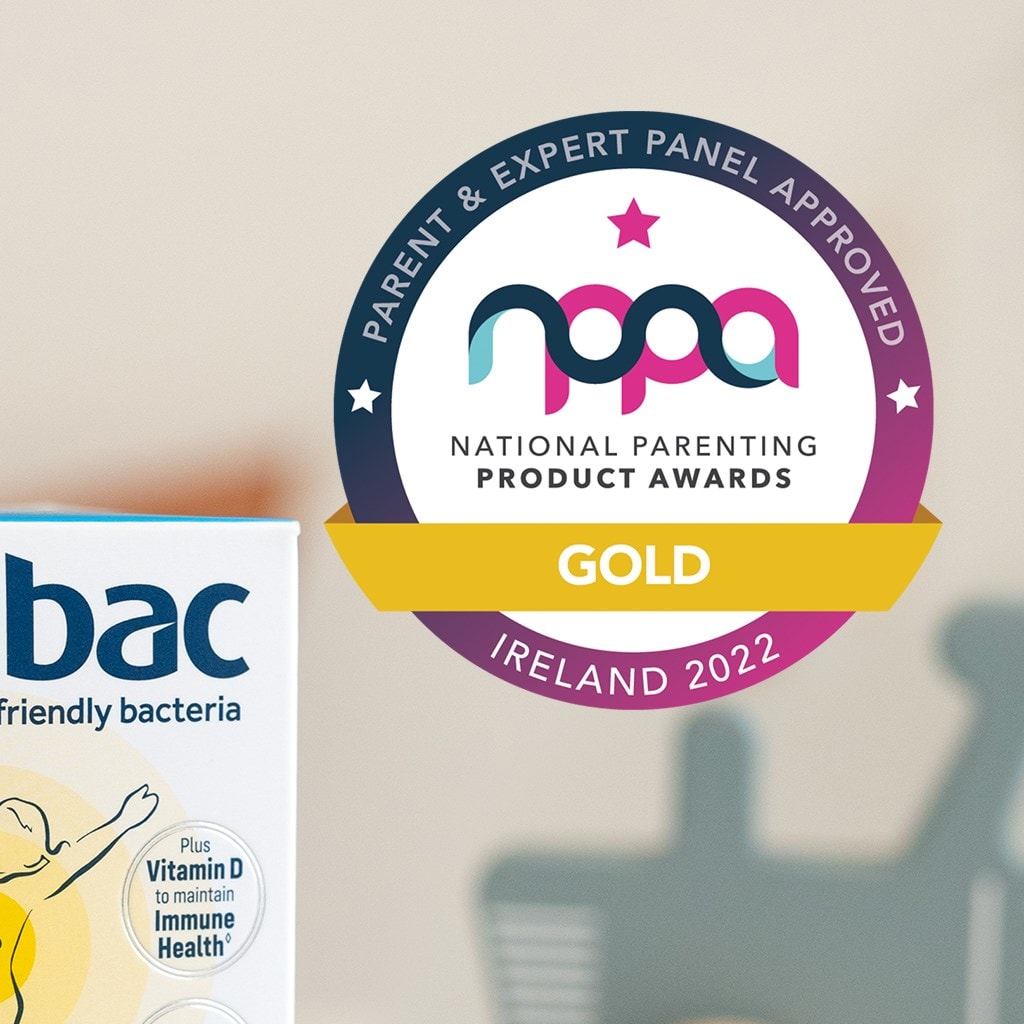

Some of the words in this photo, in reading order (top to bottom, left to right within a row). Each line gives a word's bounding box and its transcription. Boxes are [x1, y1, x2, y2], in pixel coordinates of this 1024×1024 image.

[119, 696, 242, 724] bacteria
[180, 837, 211, 854] Plus
[147, 858, 225, 882] Vitamin
[230, 858, 243, 879] D
[156, 889, 169, 904] to
[174, 887, 234, 904] maintain
[155, 910, 235, 932] Immune
